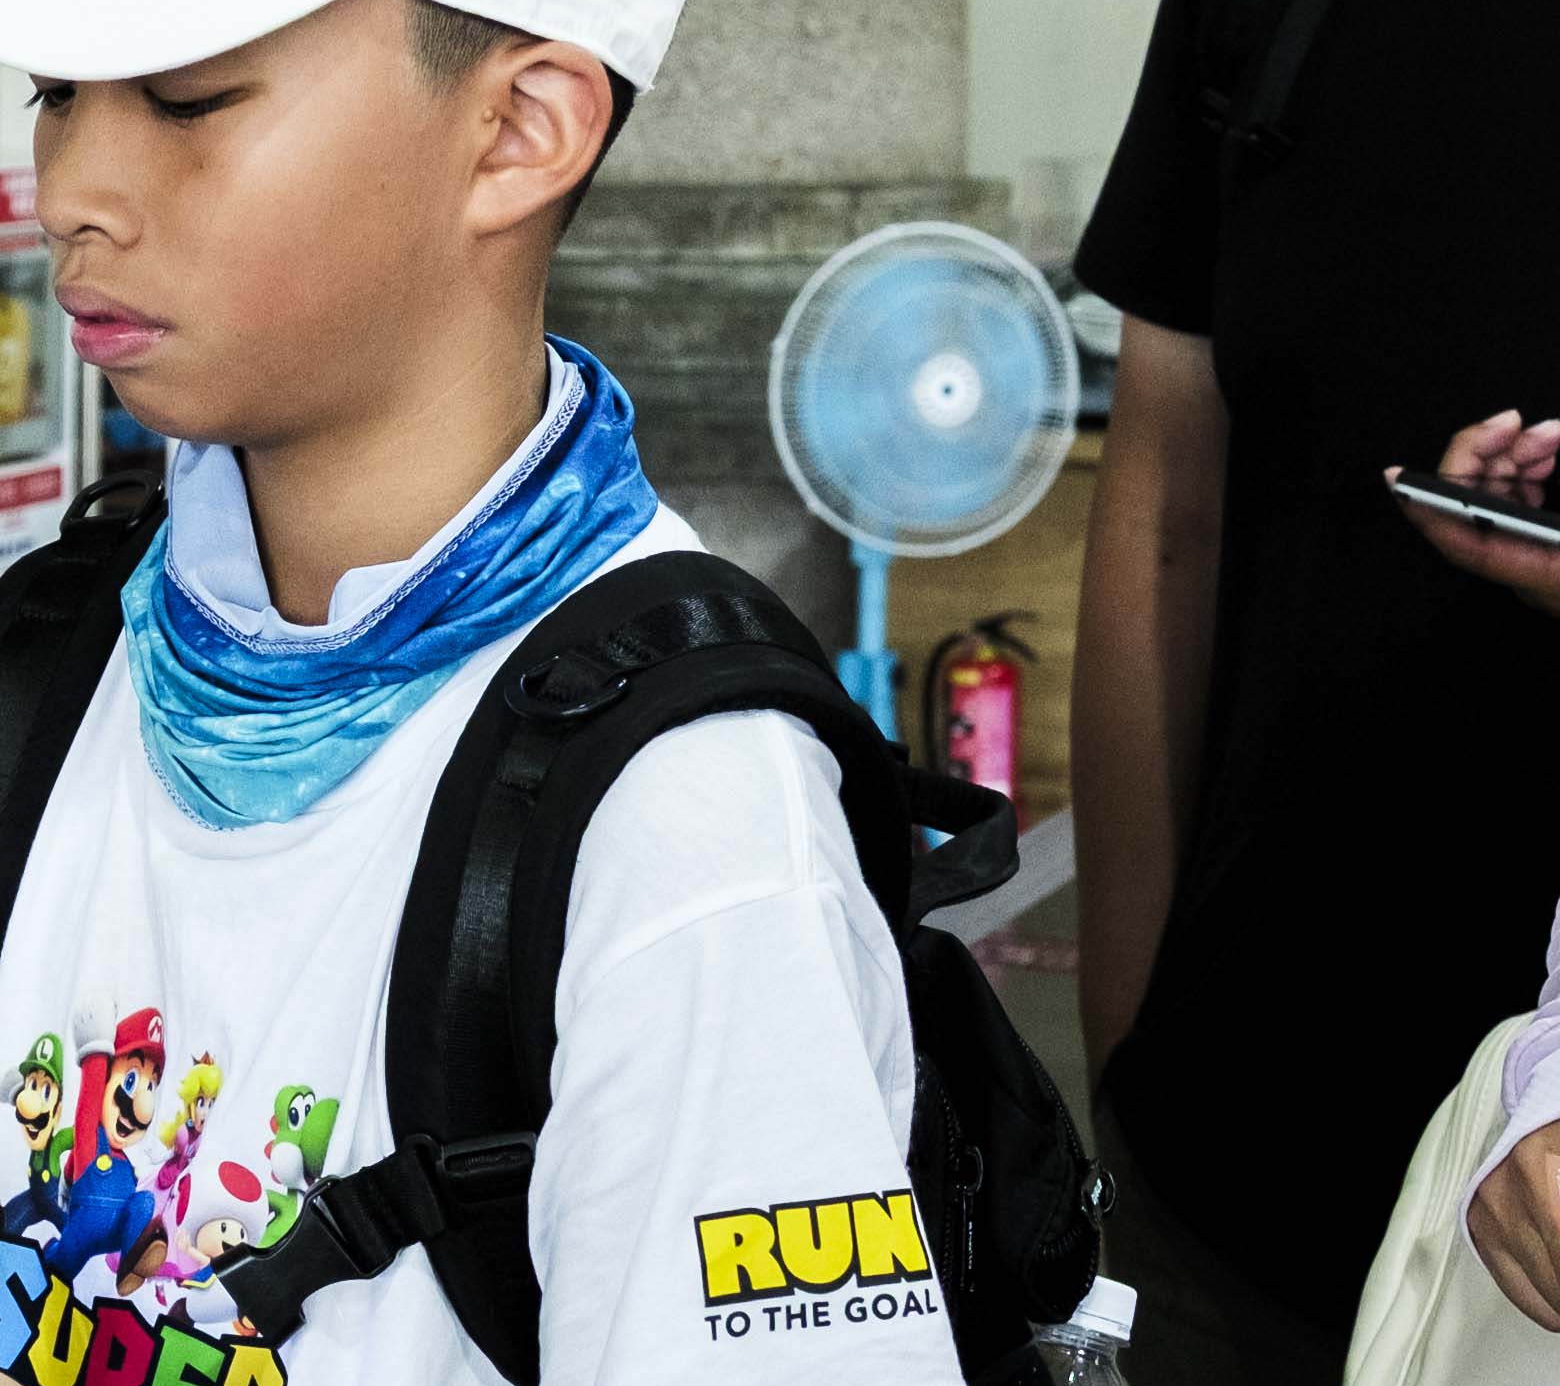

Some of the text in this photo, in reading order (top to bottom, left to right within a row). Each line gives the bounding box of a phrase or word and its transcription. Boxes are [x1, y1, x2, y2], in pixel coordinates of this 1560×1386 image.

[694, 1189, 932, 1307] RUN
[704, 1288, 939, 1341] TO THE GOAL
